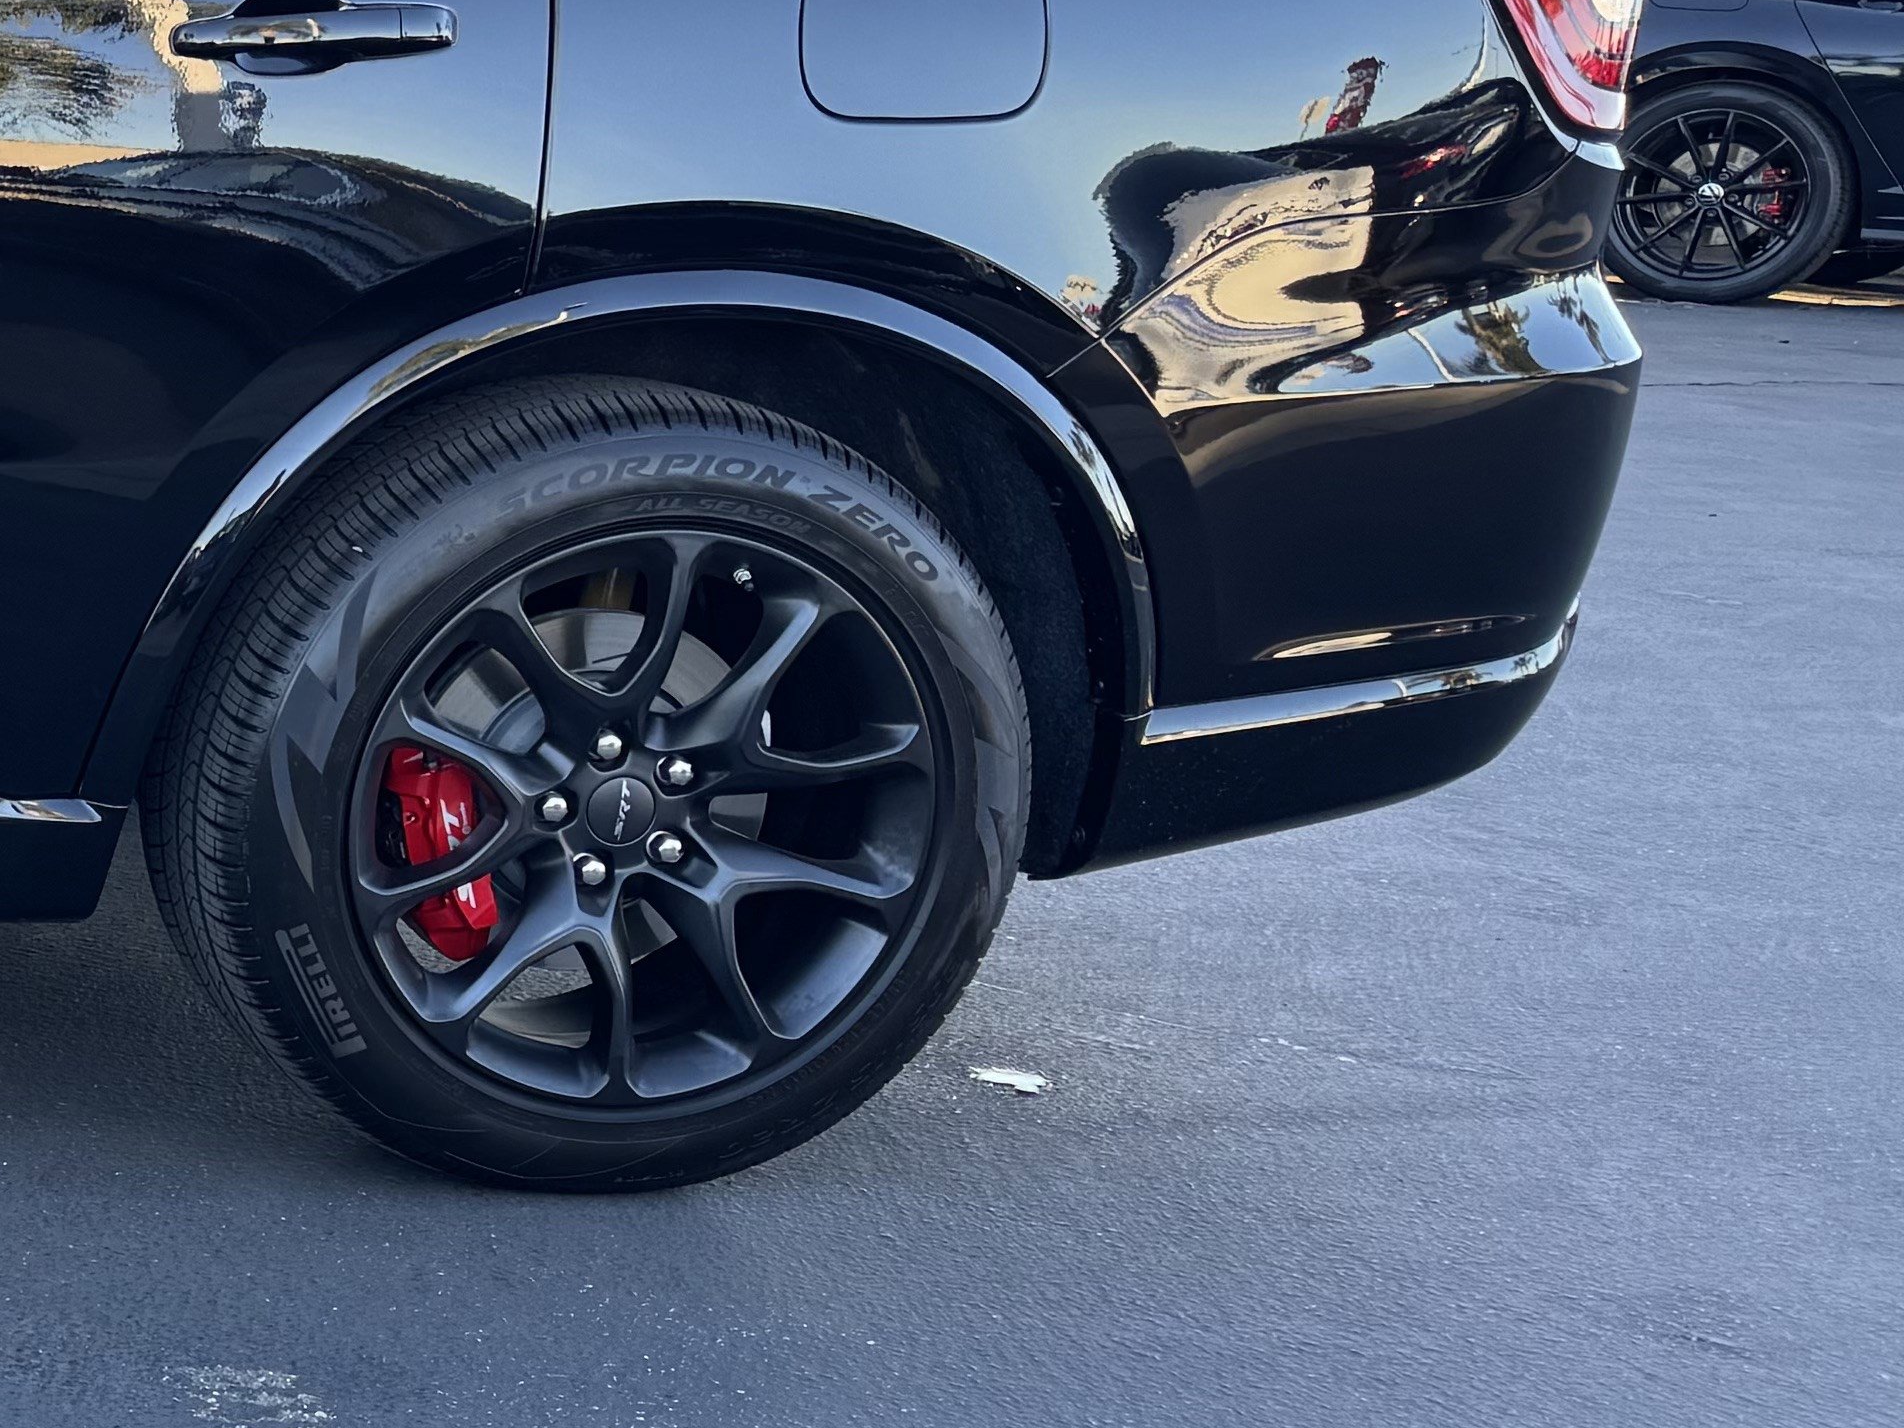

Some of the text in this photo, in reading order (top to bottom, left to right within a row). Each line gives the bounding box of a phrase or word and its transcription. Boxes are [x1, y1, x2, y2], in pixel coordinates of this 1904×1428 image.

[493, 452, 940, 582] SCORPION ZERO
[635, 495, 812, 536] ALL SEASON
[613, 778, 632, 842] SRT
[274, 922, 368, 1059] PIRELLI
